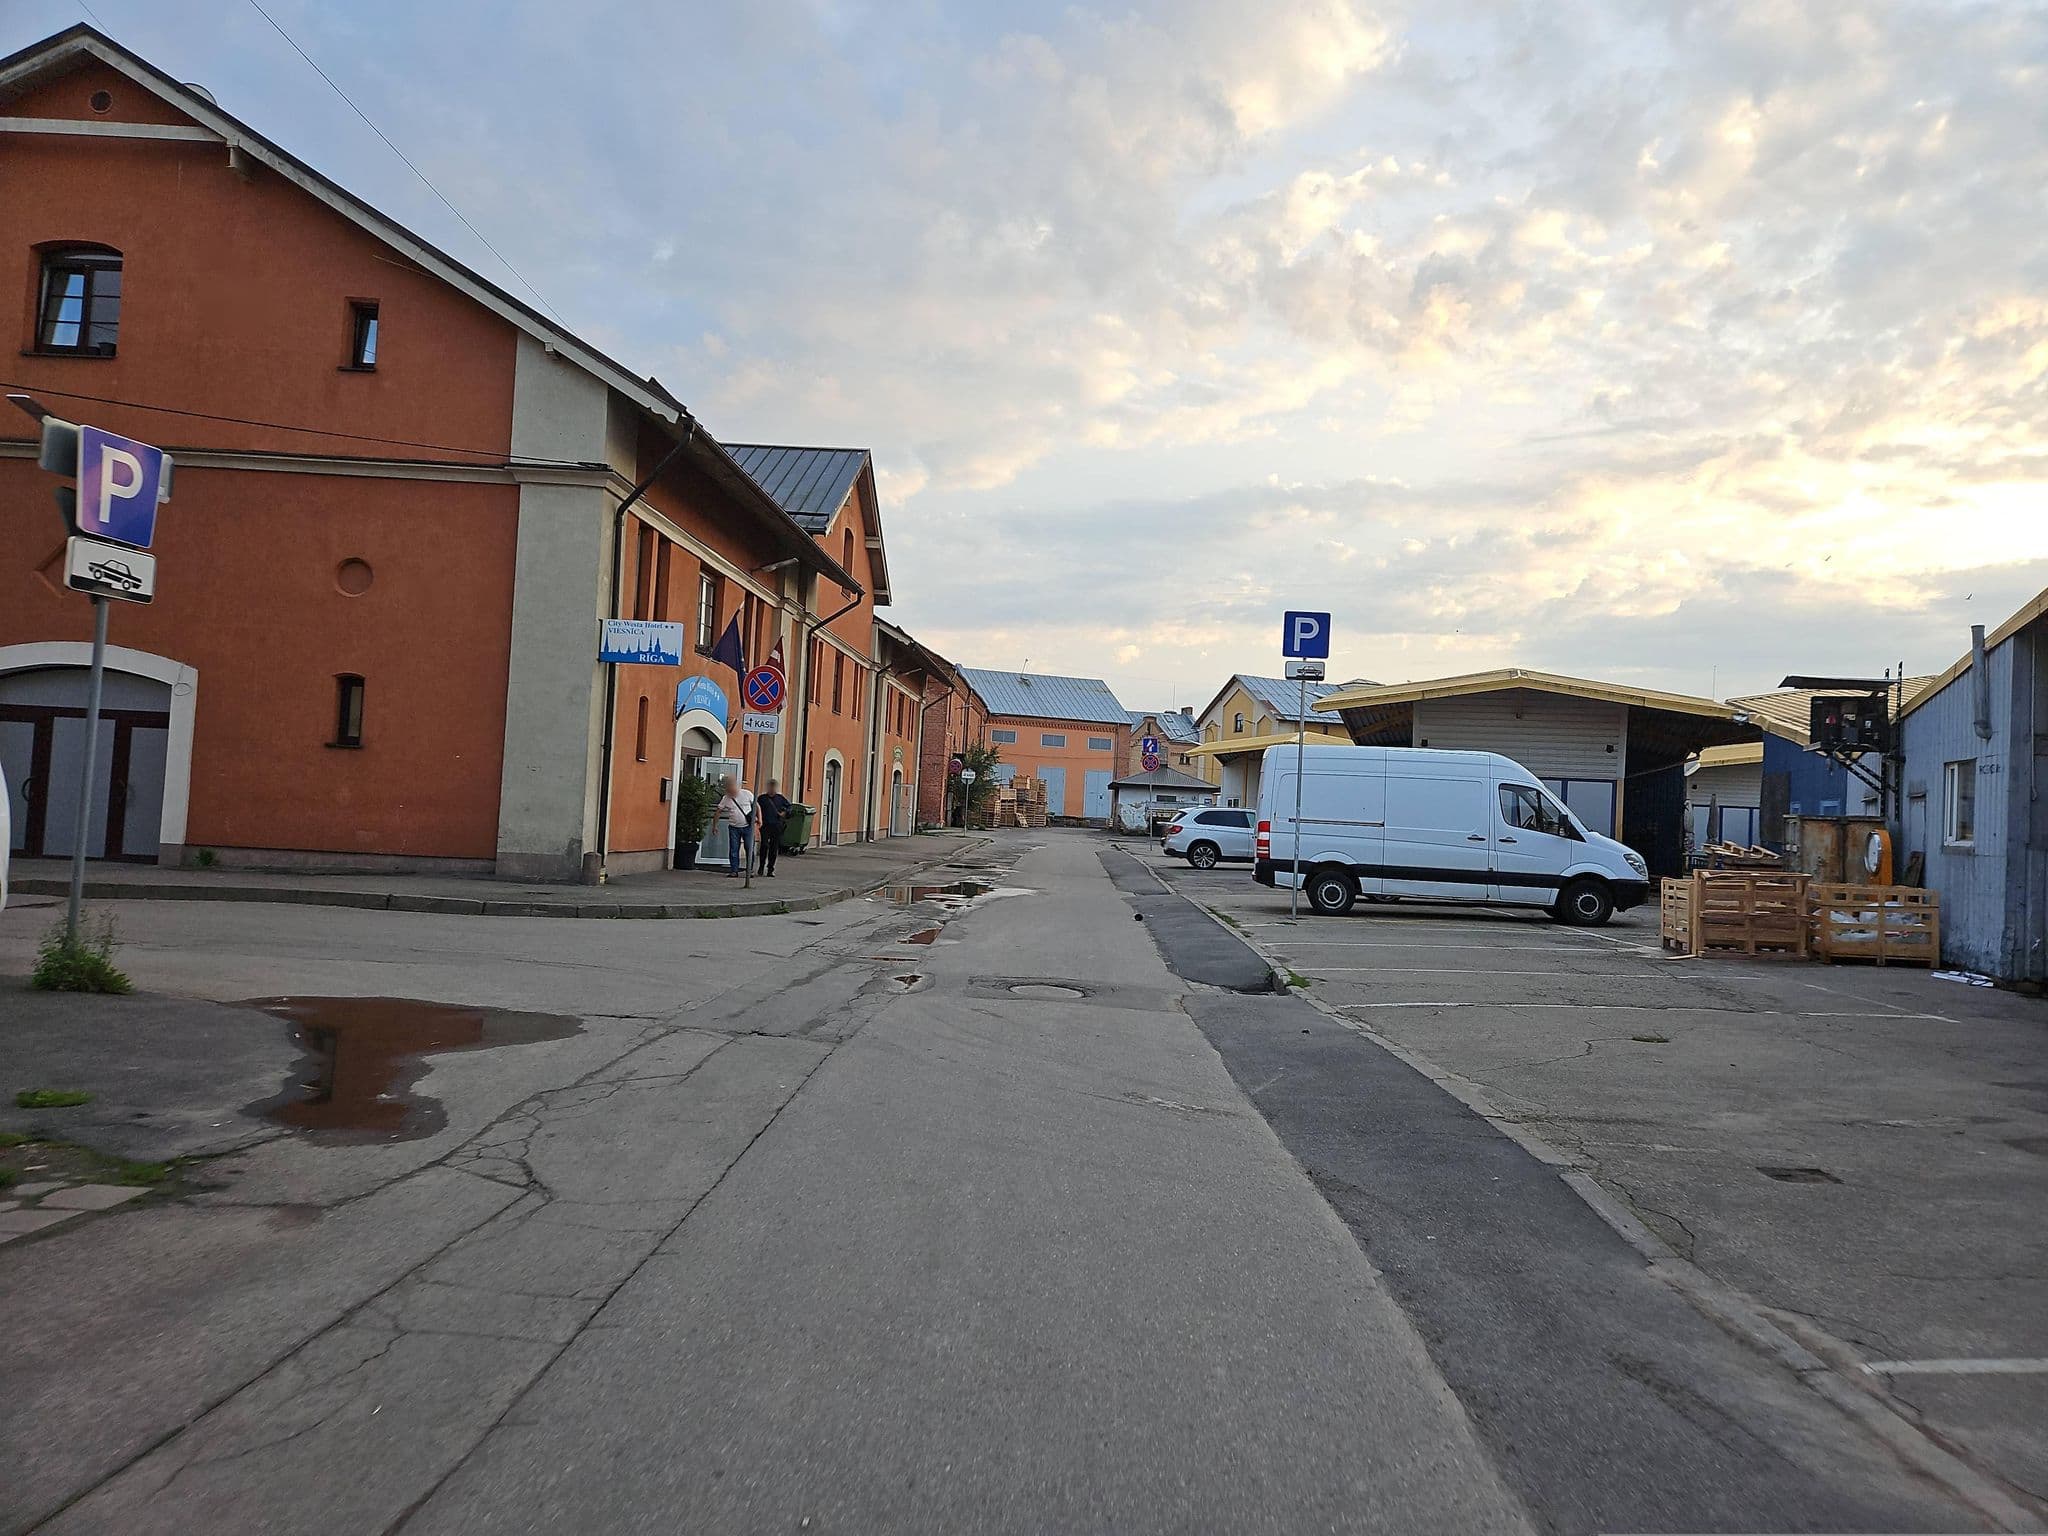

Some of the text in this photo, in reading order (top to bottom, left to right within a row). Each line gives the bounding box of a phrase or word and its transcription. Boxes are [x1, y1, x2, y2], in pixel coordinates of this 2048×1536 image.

[99, 442, 143, 523] P
[1293, 617, 1320, 652] P
[639, 653, 665, 663] RĪGA
